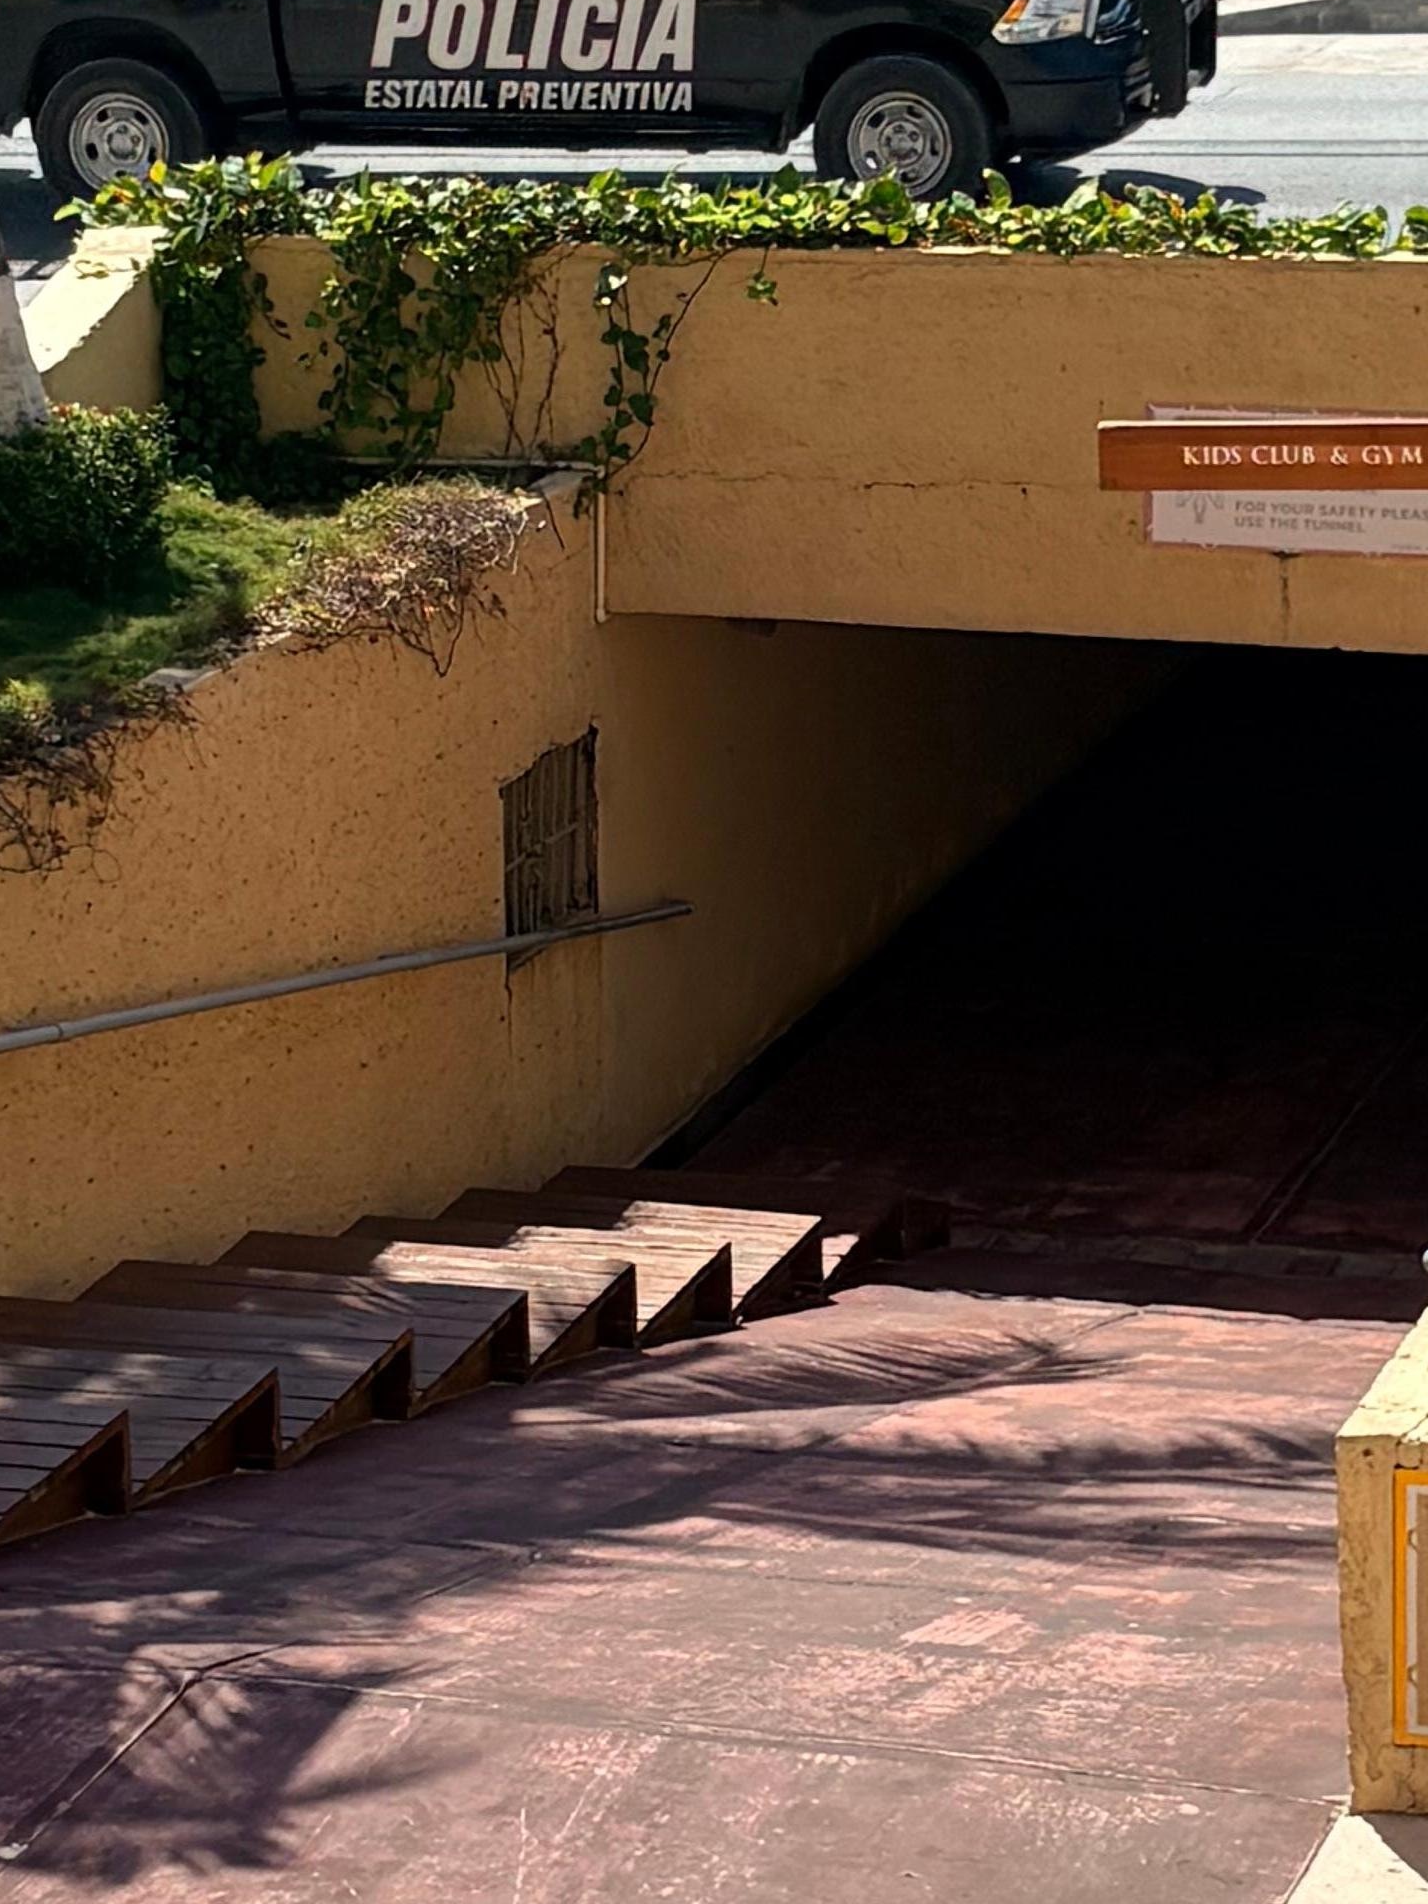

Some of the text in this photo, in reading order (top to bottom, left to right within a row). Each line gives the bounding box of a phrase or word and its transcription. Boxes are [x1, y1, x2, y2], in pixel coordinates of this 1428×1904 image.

[364, 80, 693, 111] ESTATAL PREVENTIVA
[1183, 445, 1423, 465] KIDS CLUB & GYM
[1235, 501, 1265, 513] FOR
[1270, 503, 1314, 515] YOUR
[1319, 504, 1375, 519] SAFETY
[1235, 516, 1365, 533] USE THE TUNNEL
